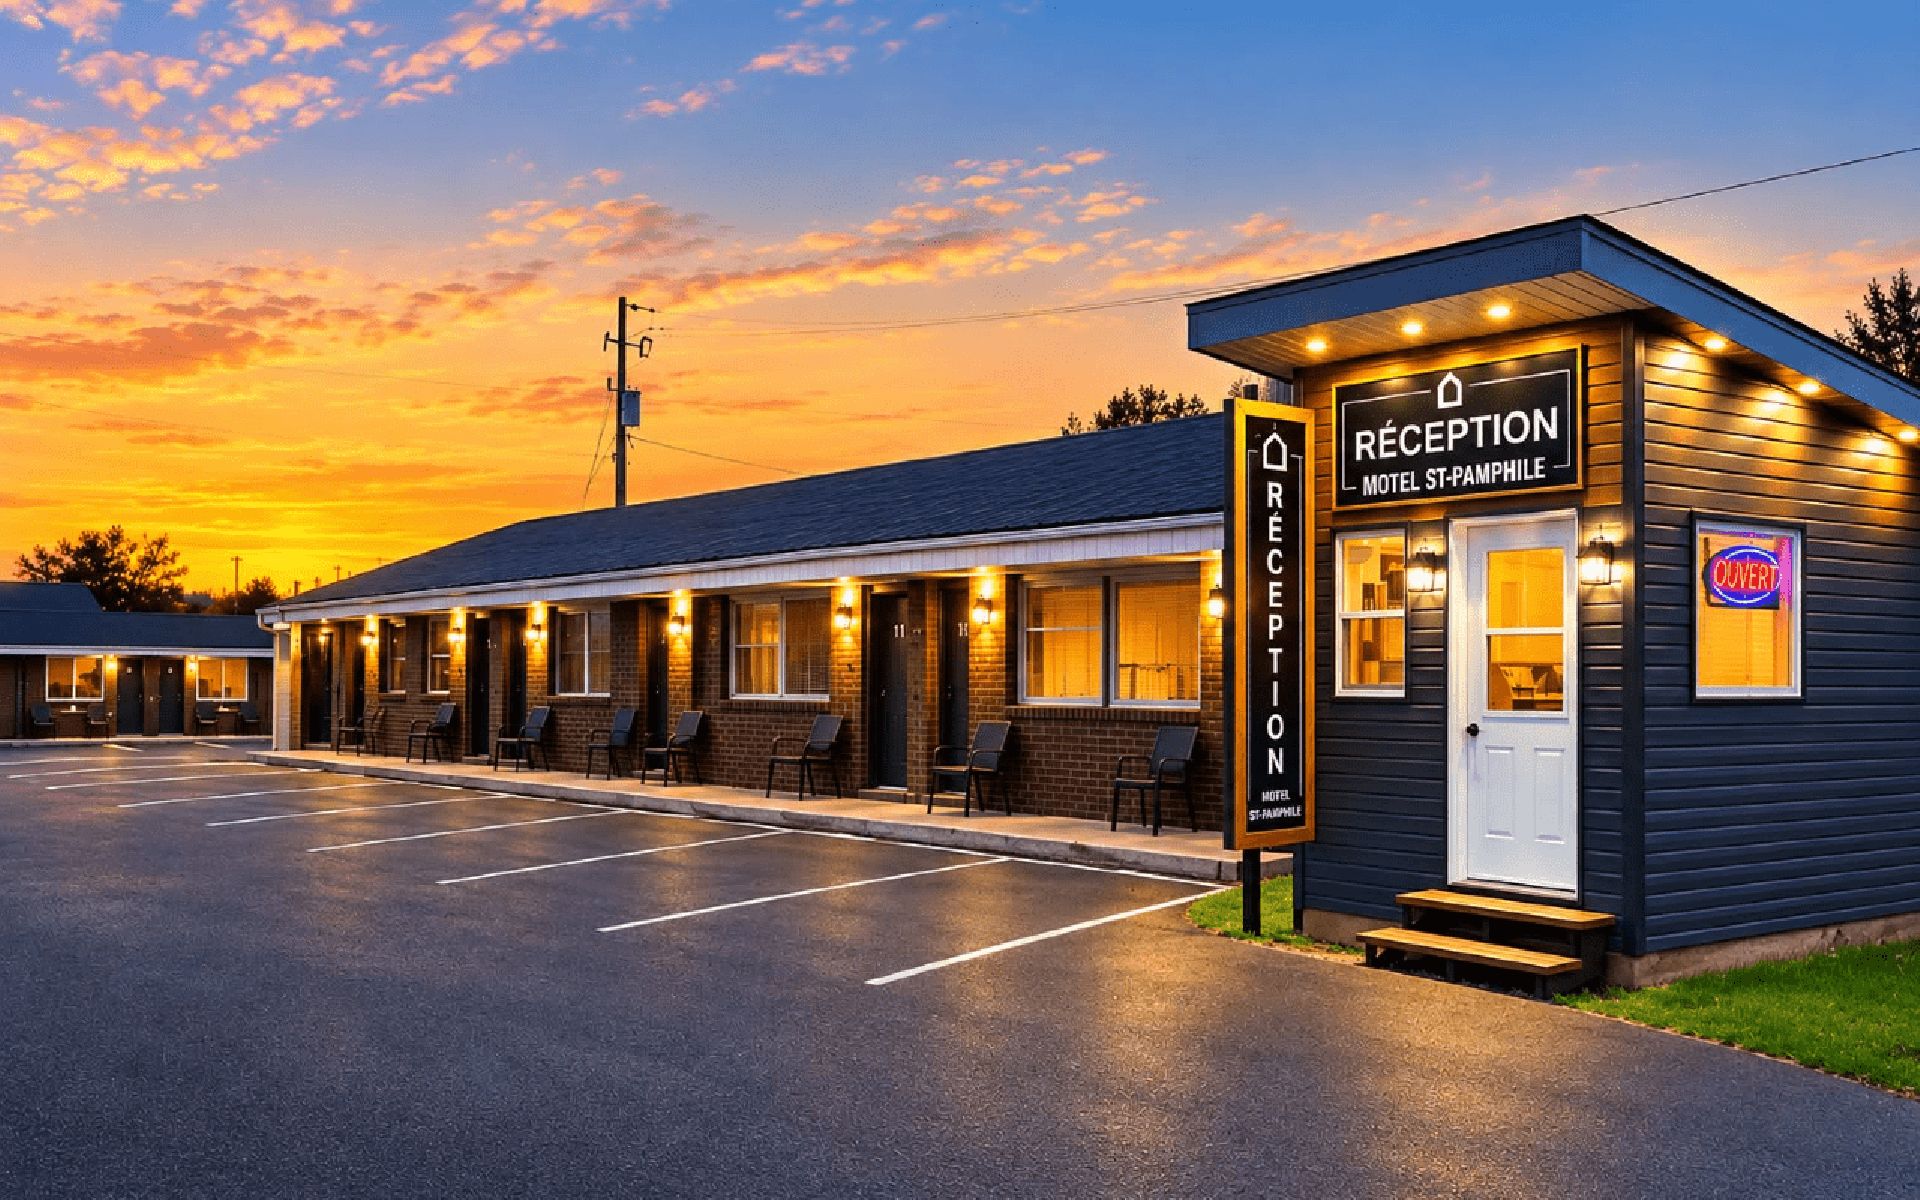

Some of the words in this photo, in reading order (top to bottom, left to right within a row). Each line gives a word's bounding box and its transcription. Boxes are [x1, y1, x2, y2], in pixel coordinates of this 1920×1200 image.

[1355, 406, 1558, 461] RÉCEPTION
[1362, 471, 1420, 496] MOTEL
[1425, 457, 1546, 490] ST-PAMPHILE
[1713, 560, 1780, 591] OUVERT
[1266, 481, 1285, 775] RÉCEPTION
[1262, 789, 1291, 802] MOTEL
